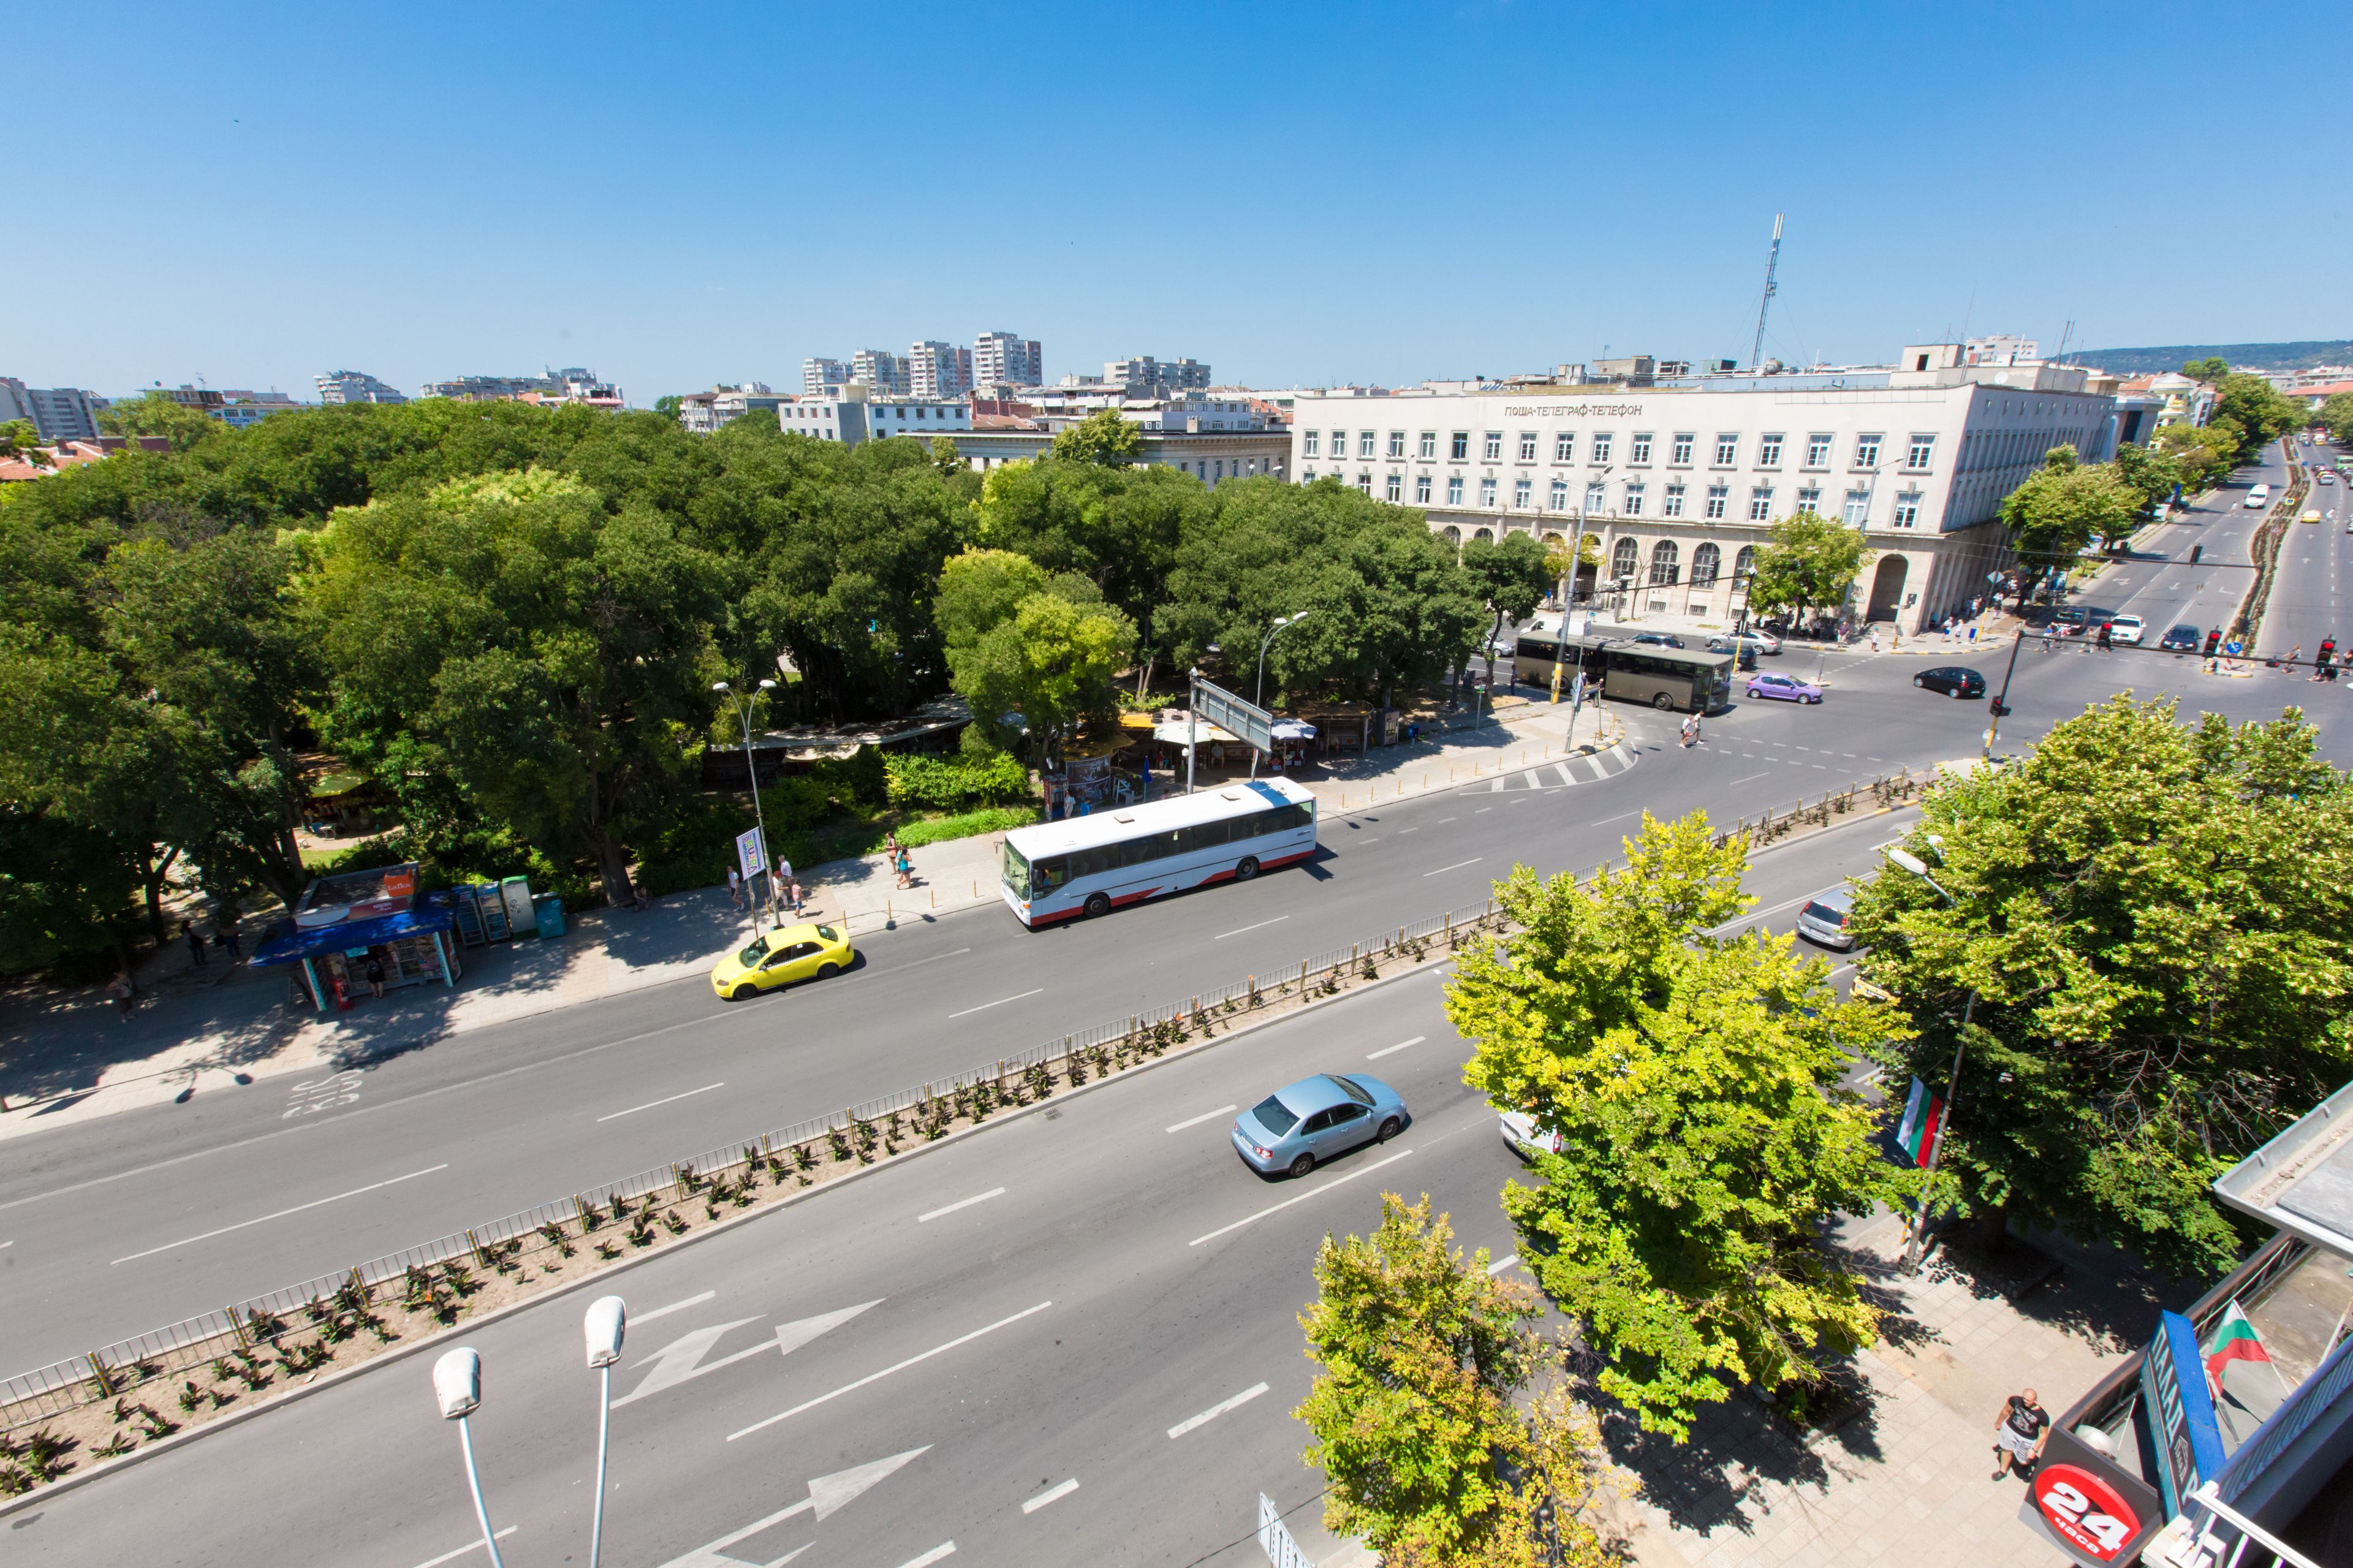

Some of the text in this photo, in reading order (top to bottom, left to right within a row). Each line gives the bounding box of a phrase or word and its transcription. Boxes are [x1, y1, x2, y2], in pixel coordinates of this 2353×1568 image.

[742, 835, 752, 844] 2017
[387, 882, 411, 891] Lafka
[2042, 1482, 2131, 1551] 24
[2055, 1517, 2100, 1554] часа
